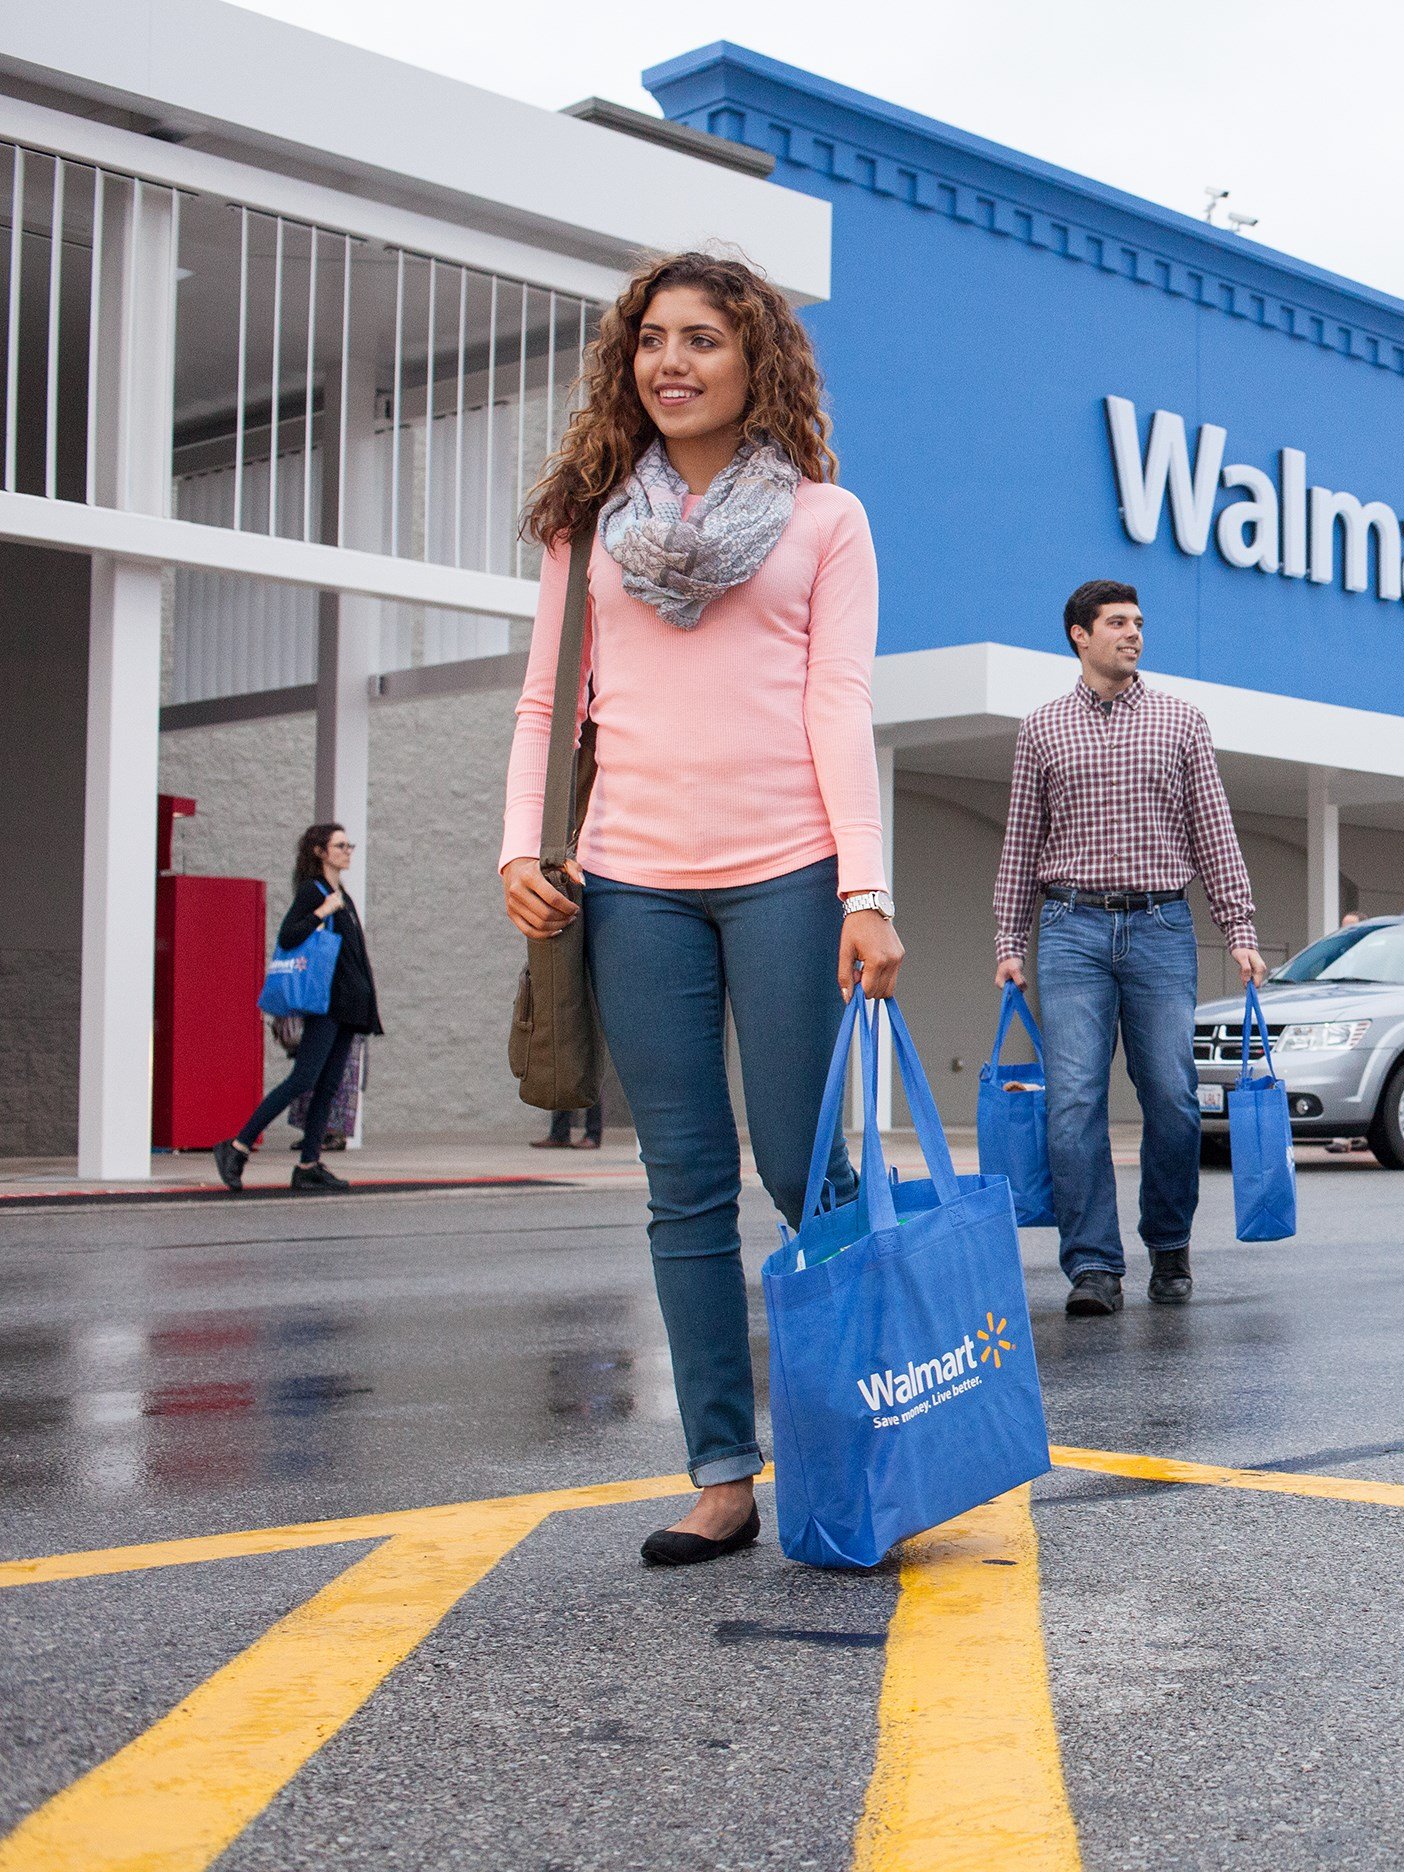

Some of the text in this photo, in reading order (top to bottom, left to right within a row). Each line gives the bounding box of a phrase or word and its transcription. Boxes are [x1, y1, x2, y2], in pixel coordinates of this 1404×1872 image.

[857, 1335, 978, 1411] Walmart
[873, 1376, 983, 1429] Save money. Live better.
